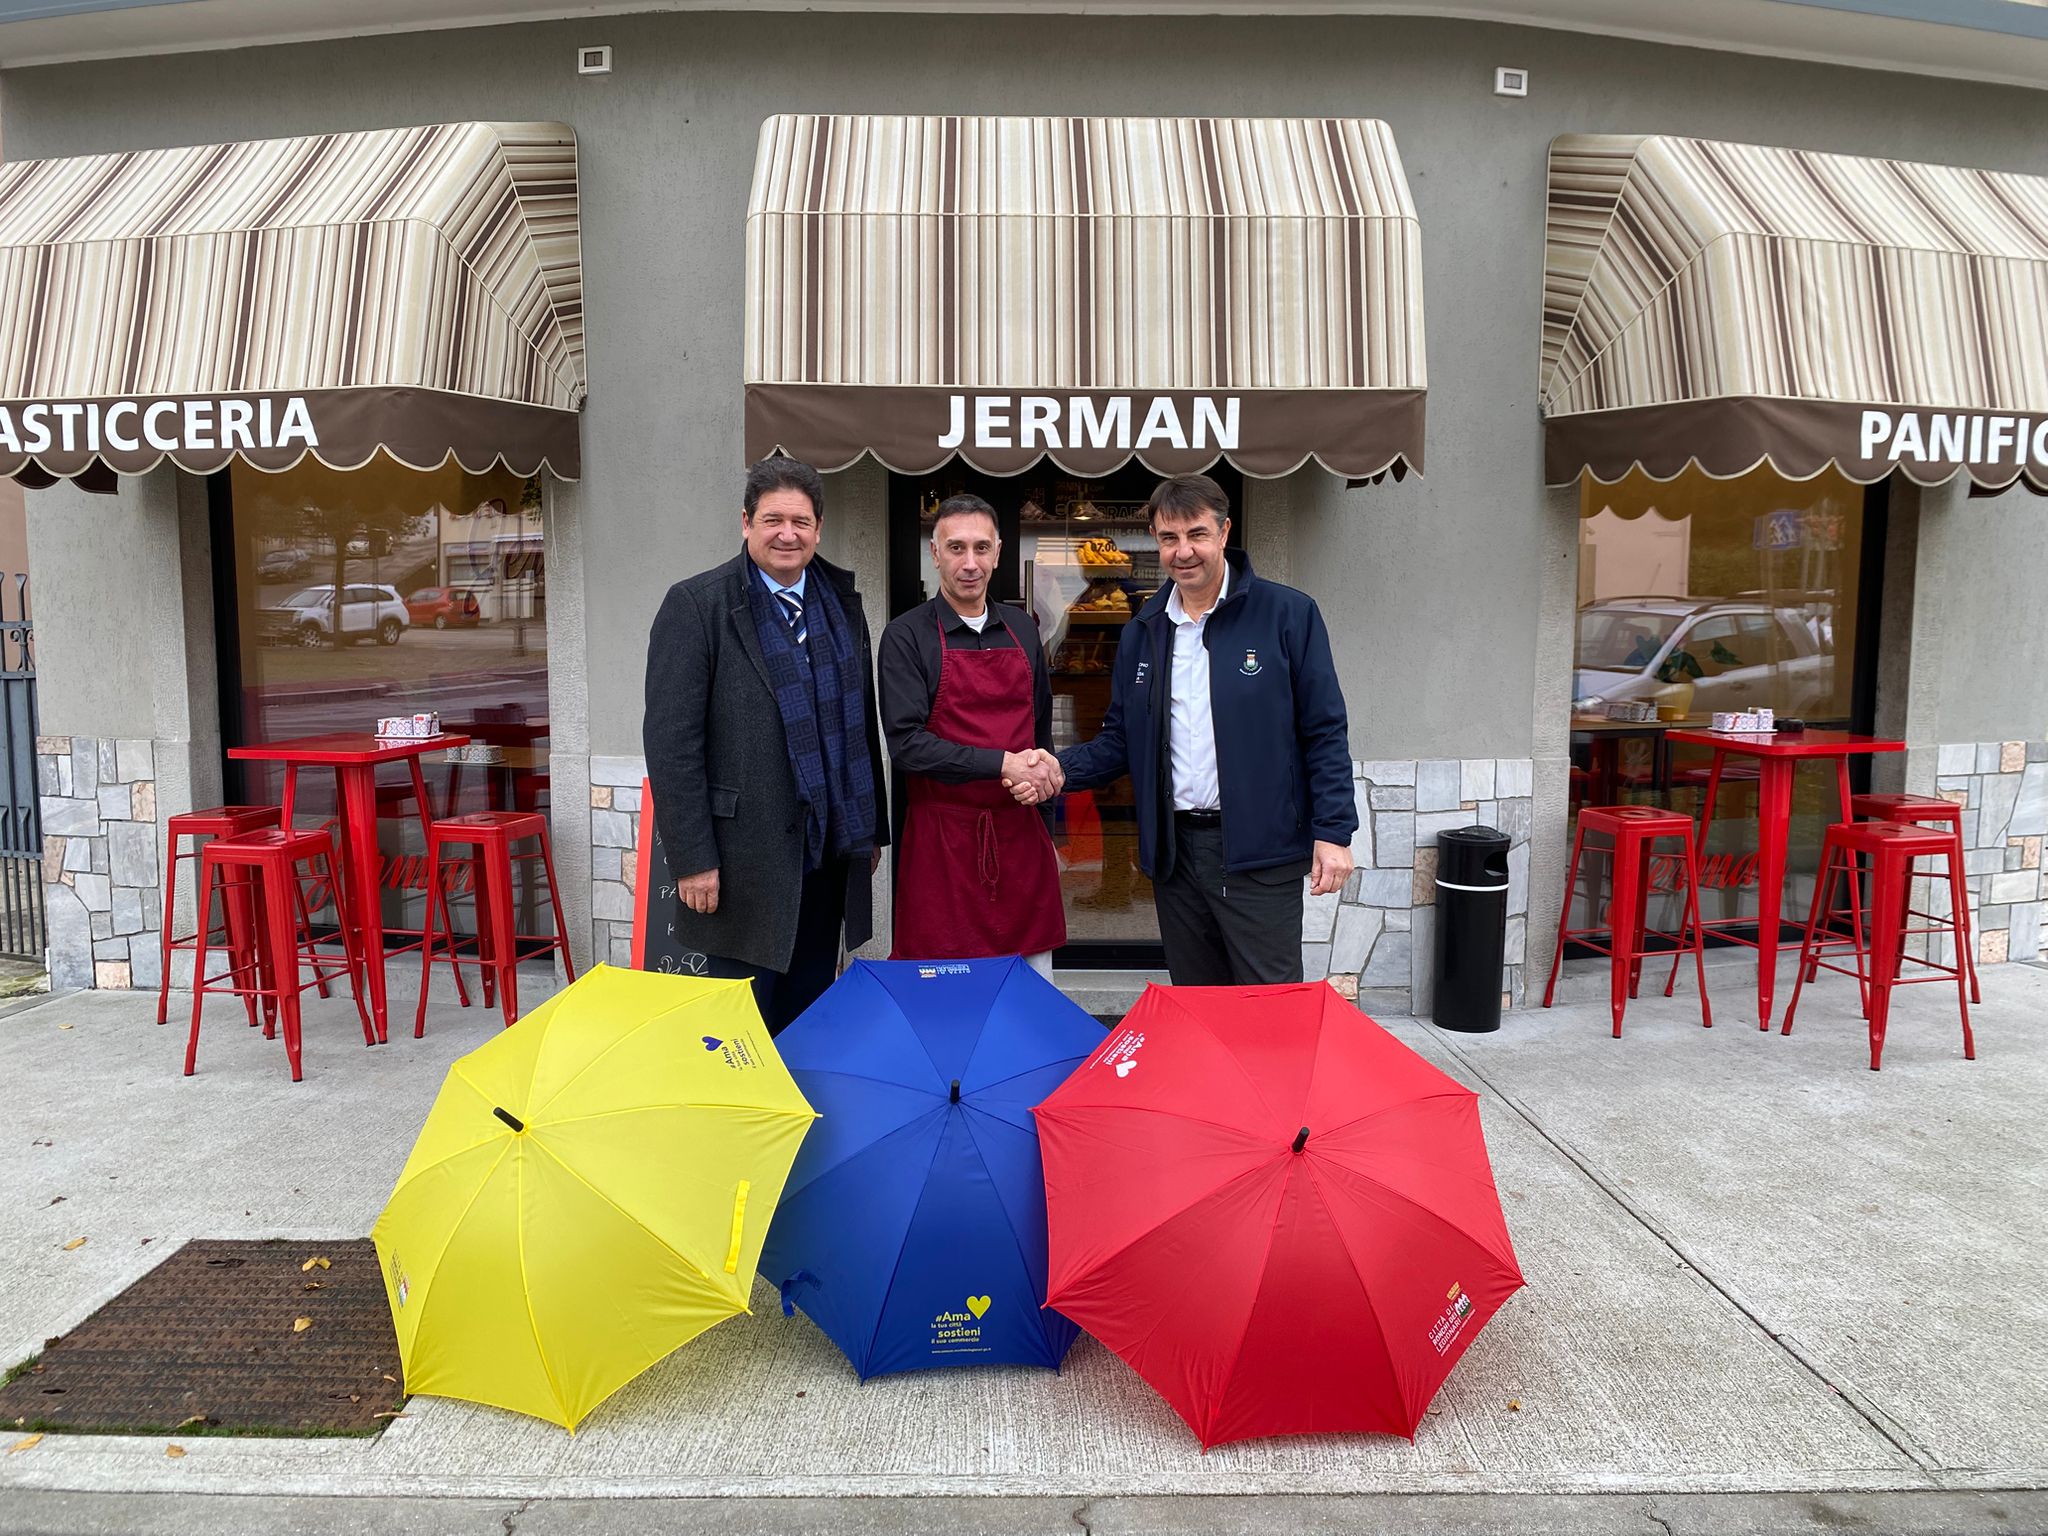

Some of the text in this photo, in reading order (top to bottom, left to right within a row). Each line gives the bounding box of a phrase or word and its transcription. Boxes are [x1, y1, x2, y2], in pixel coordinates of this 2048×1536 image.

[937, 395, 1241, 449] JERMAN
[1090, 542, 1118, 552] 07.00
[935, 1311, 971, 1323] #Ama
[1432, 1311, 1458, 1346] RONCHI DEI
[937, 1326, 981, 1338] sostieni
[1436, 1317, 1462, 1353] LEGIONARI
